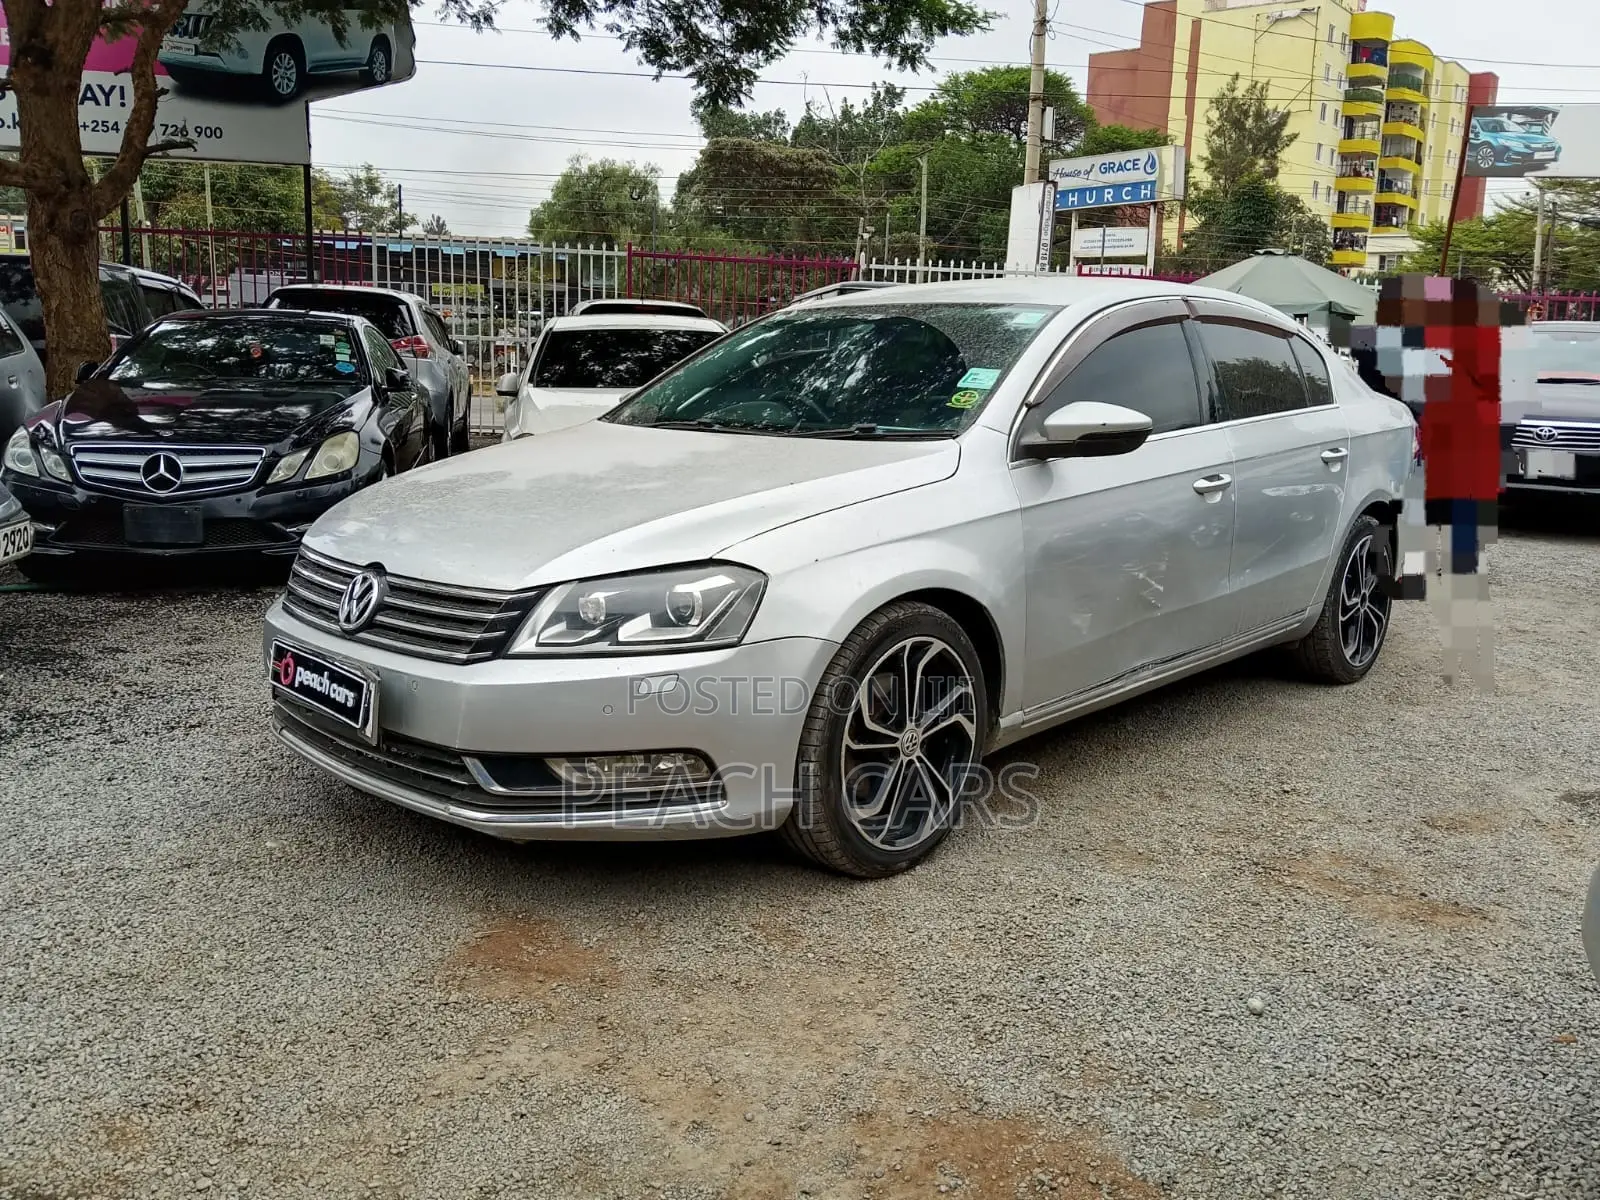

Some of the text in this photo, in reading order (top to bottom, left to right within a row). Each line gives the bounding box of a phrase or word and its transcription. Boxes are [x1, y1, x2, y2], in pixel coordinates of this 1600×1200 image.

[79, 83, 126, 108] AY!
[80, 119, 120, 134] +254
[194, 126, 223, 139] 900
[1052, 158, 1141, 180] House of GRACE
[296, 666, 355, 707] peach cars
